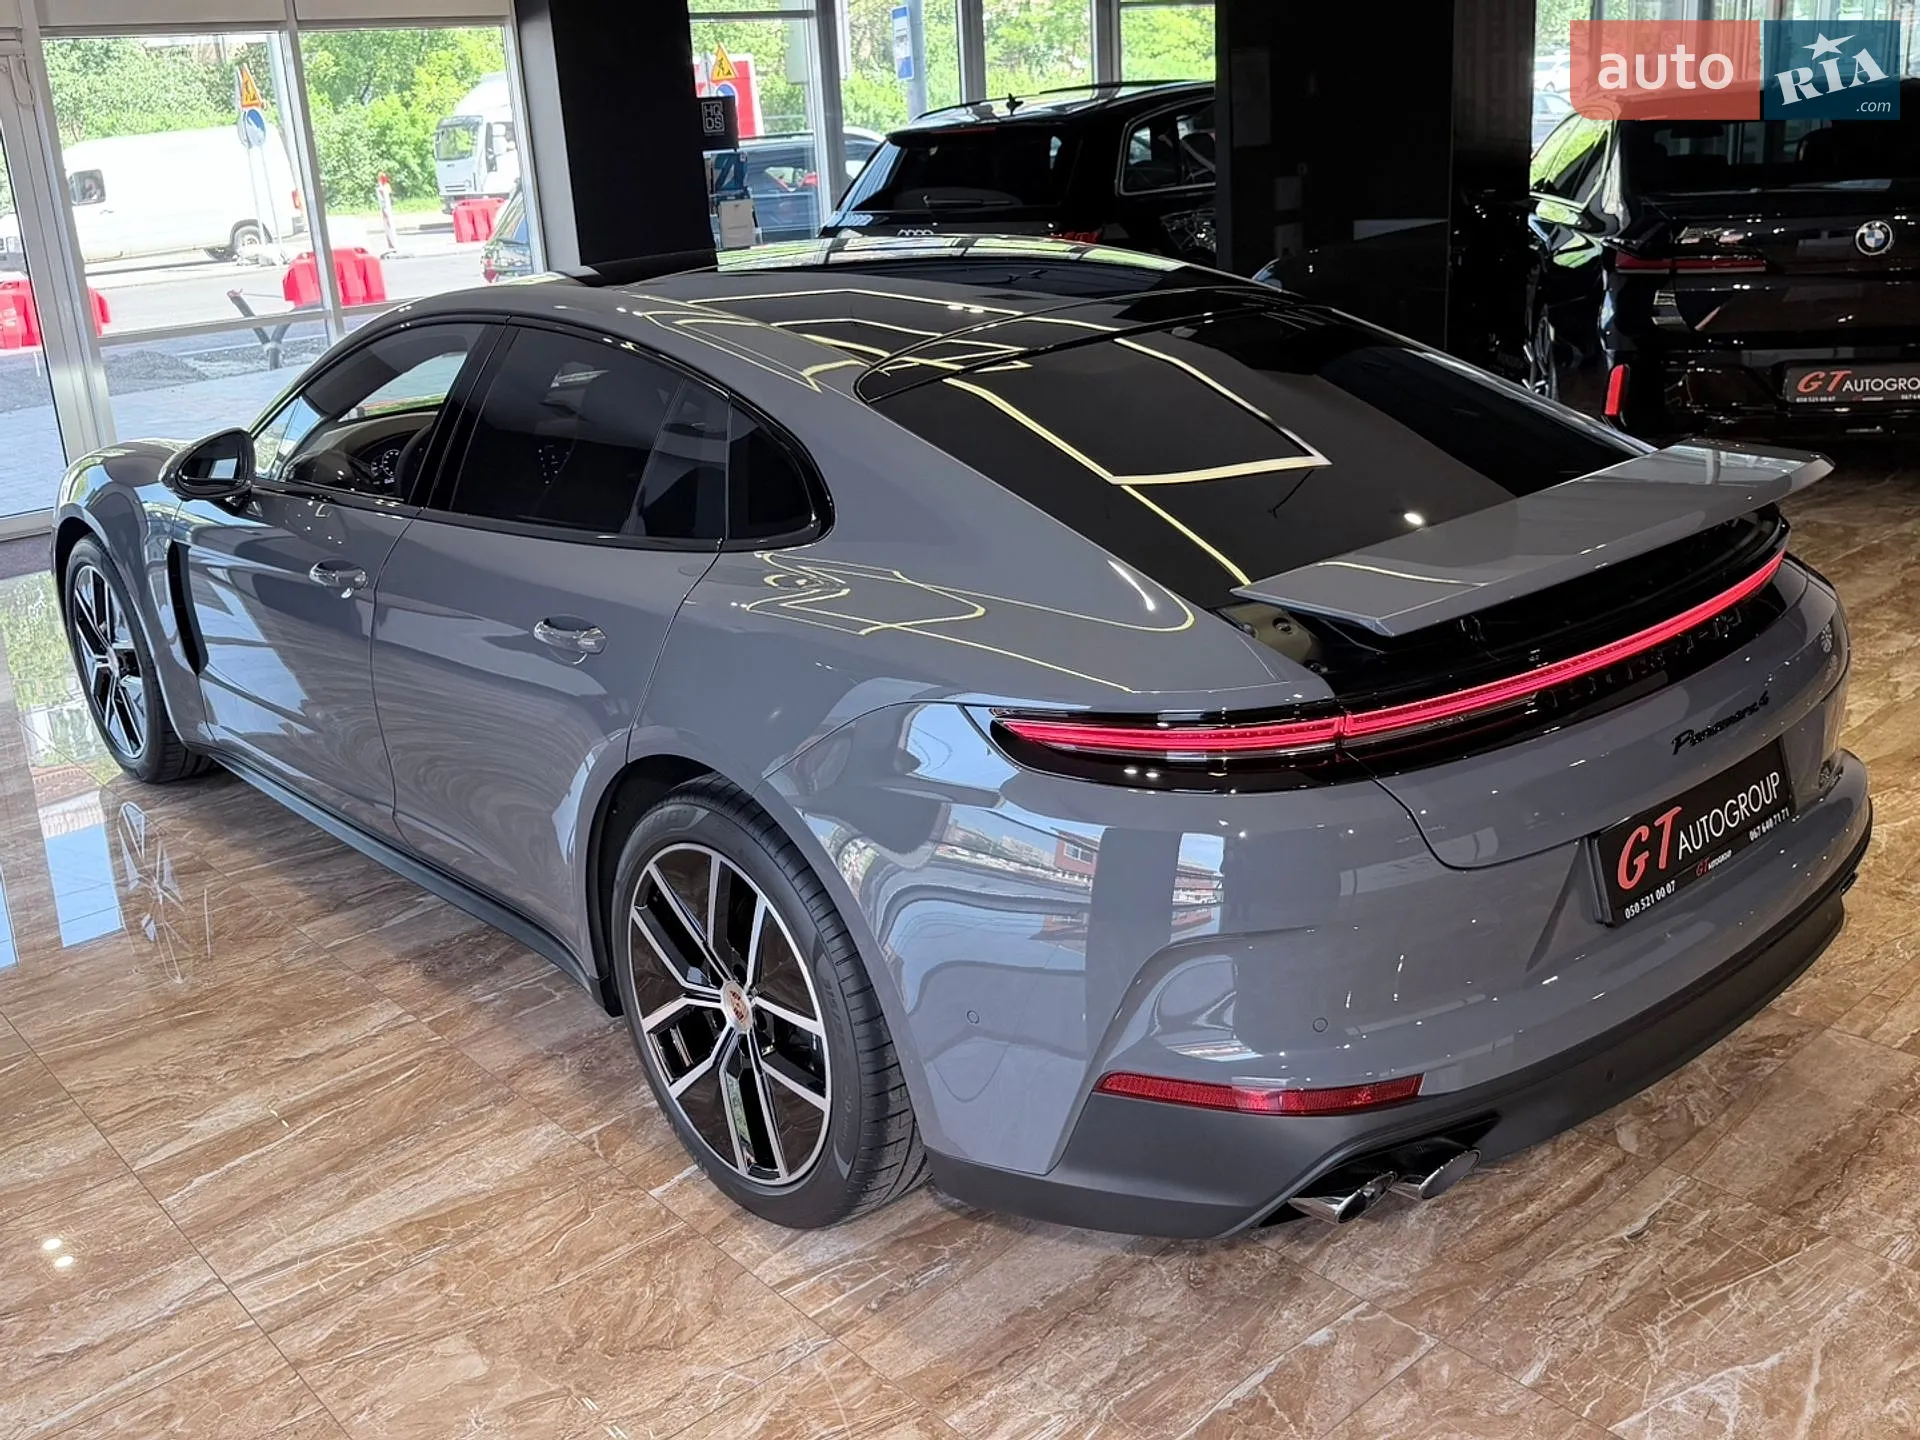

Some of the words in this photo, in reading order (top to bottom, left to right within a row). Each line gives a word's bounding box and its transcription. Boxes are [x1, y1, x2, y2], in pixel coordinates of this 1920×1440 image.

[1797, 370, 1852, 393] GT
[1617, 806, 1682, 890] GT
[1678, 771, 1780, 861] AUTOGROUP
[1625, 902, 1640, 919] 050
[1640, 893, 1655, 911] 521
[1655, 886, 1666, 901] 00
[1665, 879, 1676, 894] 07
